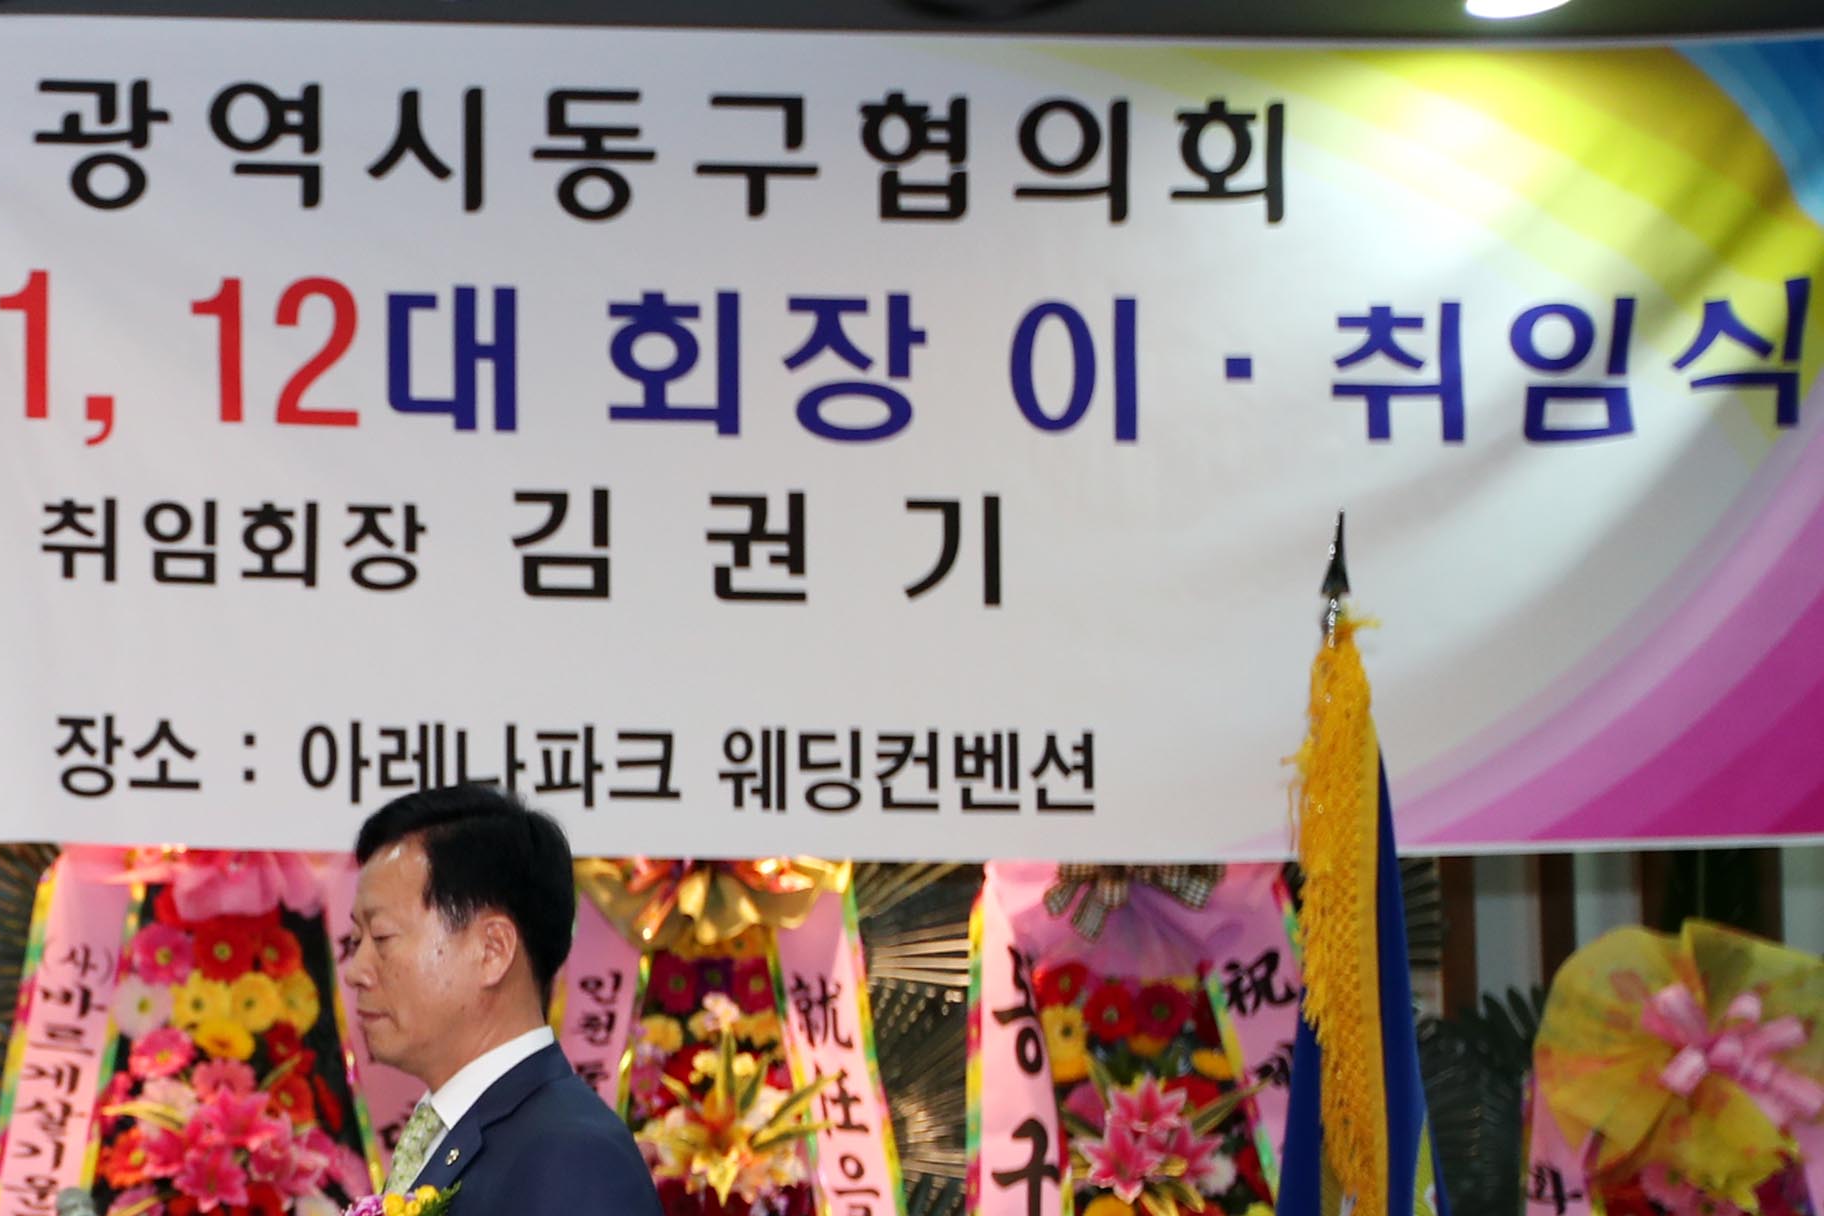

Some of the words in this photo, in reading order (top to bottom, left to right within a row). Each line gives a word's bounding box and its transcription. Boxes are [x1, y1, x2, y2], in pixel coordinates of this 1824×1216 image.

[191, 277, 518, 432] 12대
[608, 290, 927, 443] 회장
[41, 498, 426, 592] 취임회장
[56, 715, 201, 798] 장소
[301, 721, 681, 808] 아레나파크
[718, 728, 1095, 813] 웨딩컨벤션
[1225, 949, 1298, 1016] 祝
